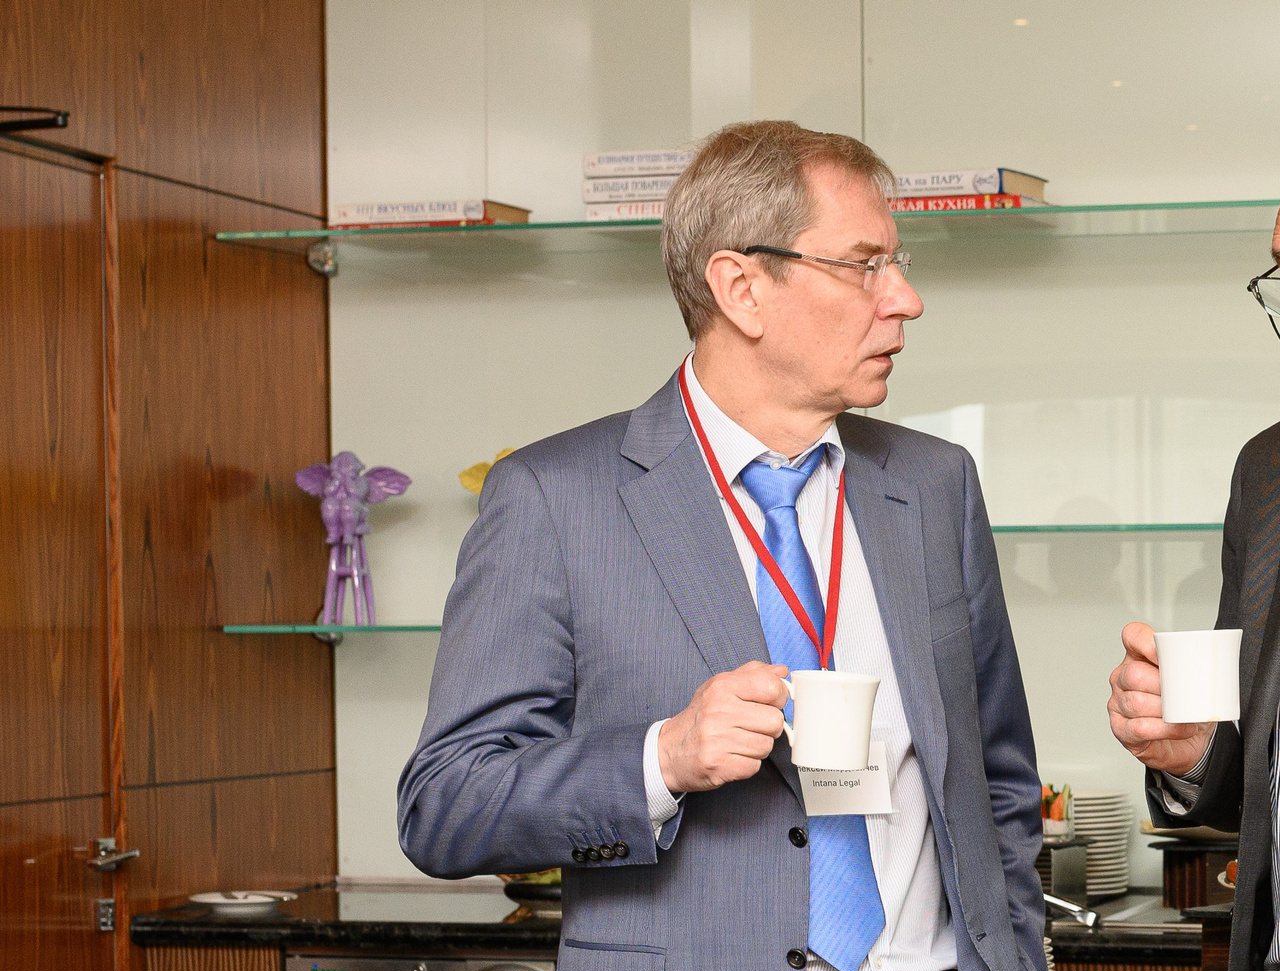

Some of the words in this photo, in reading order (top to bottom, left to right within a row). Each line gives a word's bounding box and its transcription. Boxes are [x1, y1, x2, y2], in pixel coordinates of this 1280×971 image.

[930, 174, 963, 185] ПАРУ
[928, 197, 976, 211] КУХНЯ
[839, 779, 861, 788] Legal
